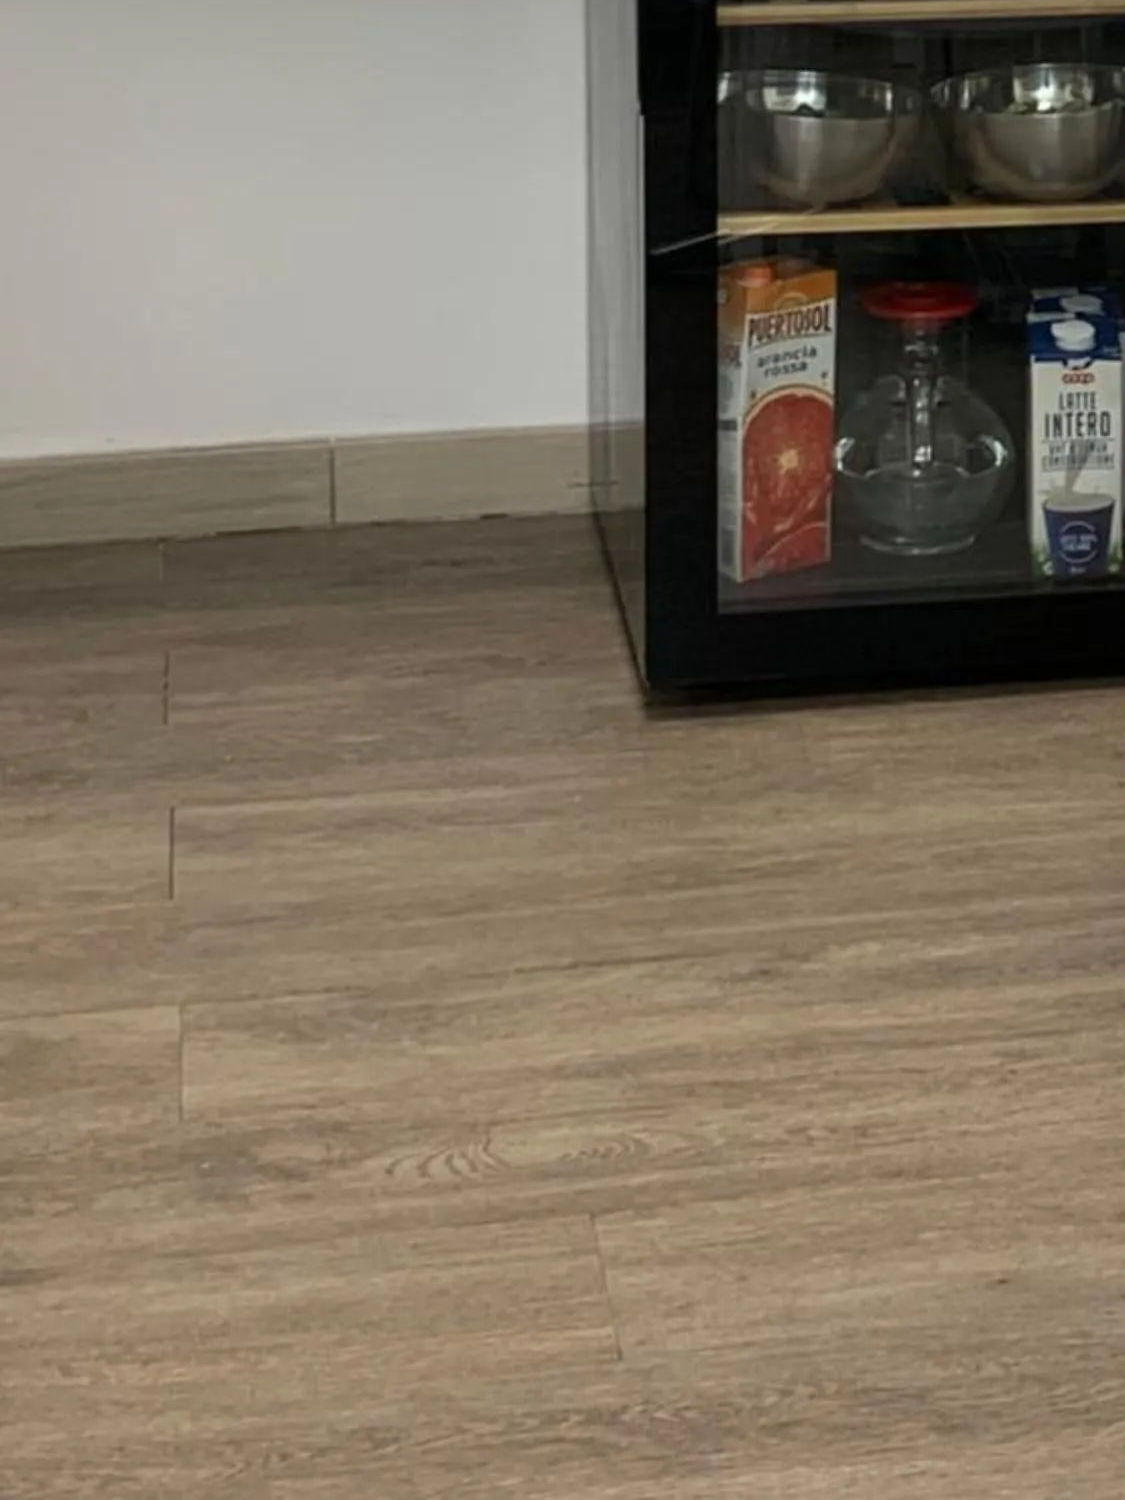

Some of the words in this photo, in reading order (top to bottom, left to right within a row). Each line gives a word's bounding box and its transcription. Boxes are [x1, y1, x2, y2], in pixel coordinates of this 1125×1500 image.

[748, 303, 833, 349] PUERTOSOL
[757, 344, 817, 368] arancia
[764, 361, 808, 379] rossa
[1058, 391, 1097, 411] LATTE
[1044, 411, 1112, 438] INTERO
